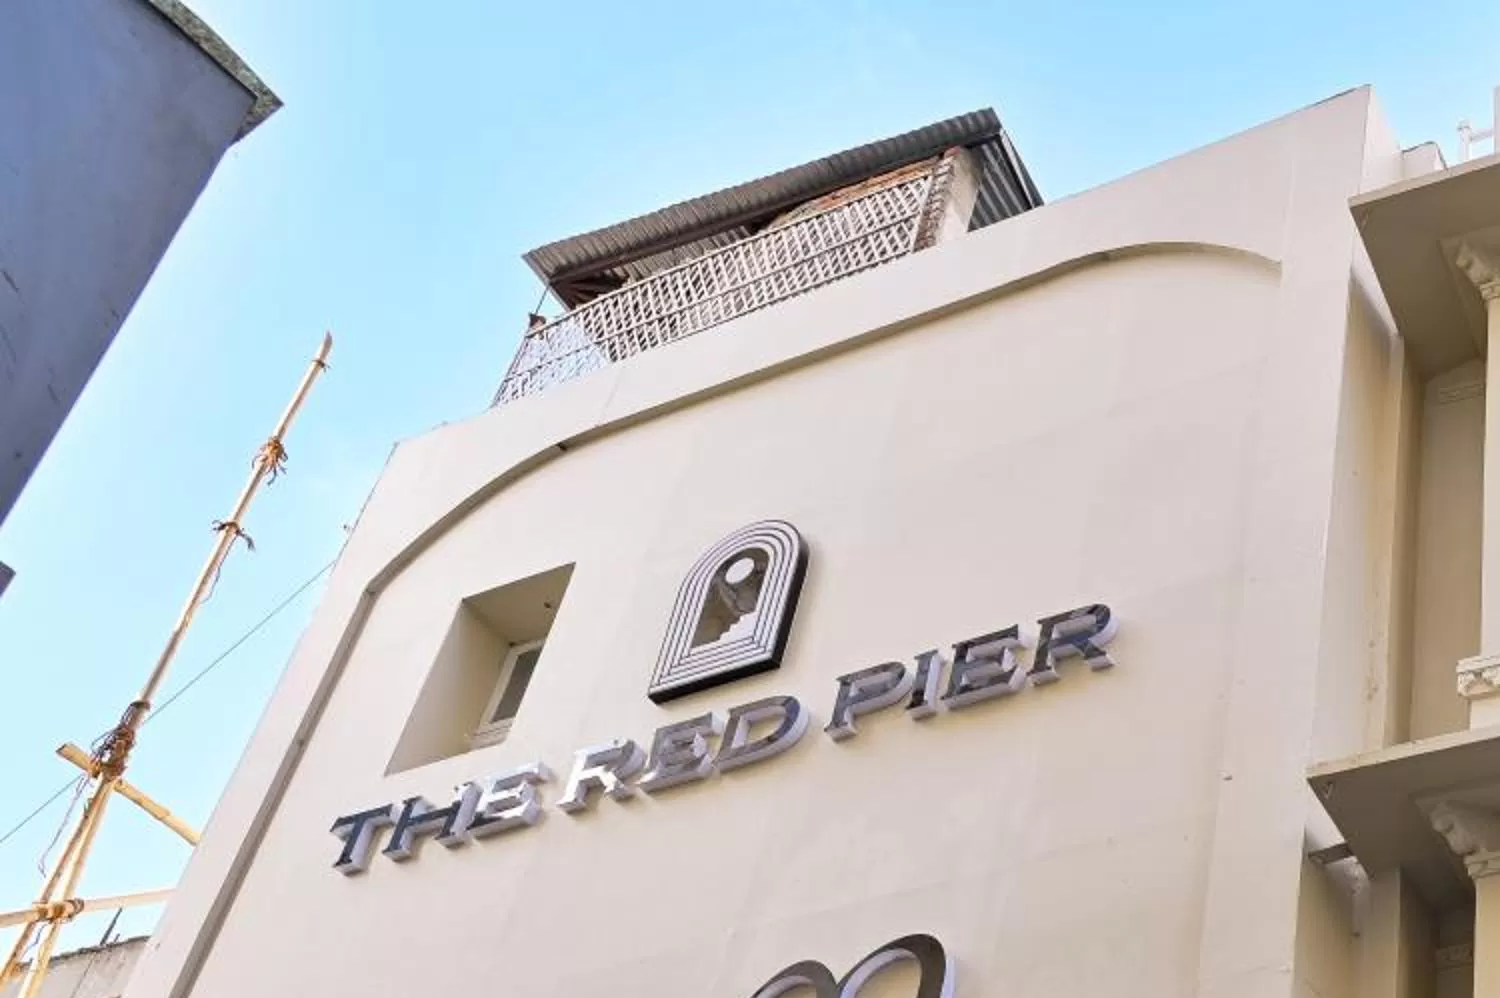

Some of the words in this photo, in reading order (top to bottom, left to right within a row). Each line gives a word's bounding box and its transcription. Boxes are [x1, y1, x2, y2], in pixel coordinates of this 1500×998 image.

[331, 760, 550, 875] THE
[556, 694, 808, 814] RED
[823, 603, 1121, 741] PIER
